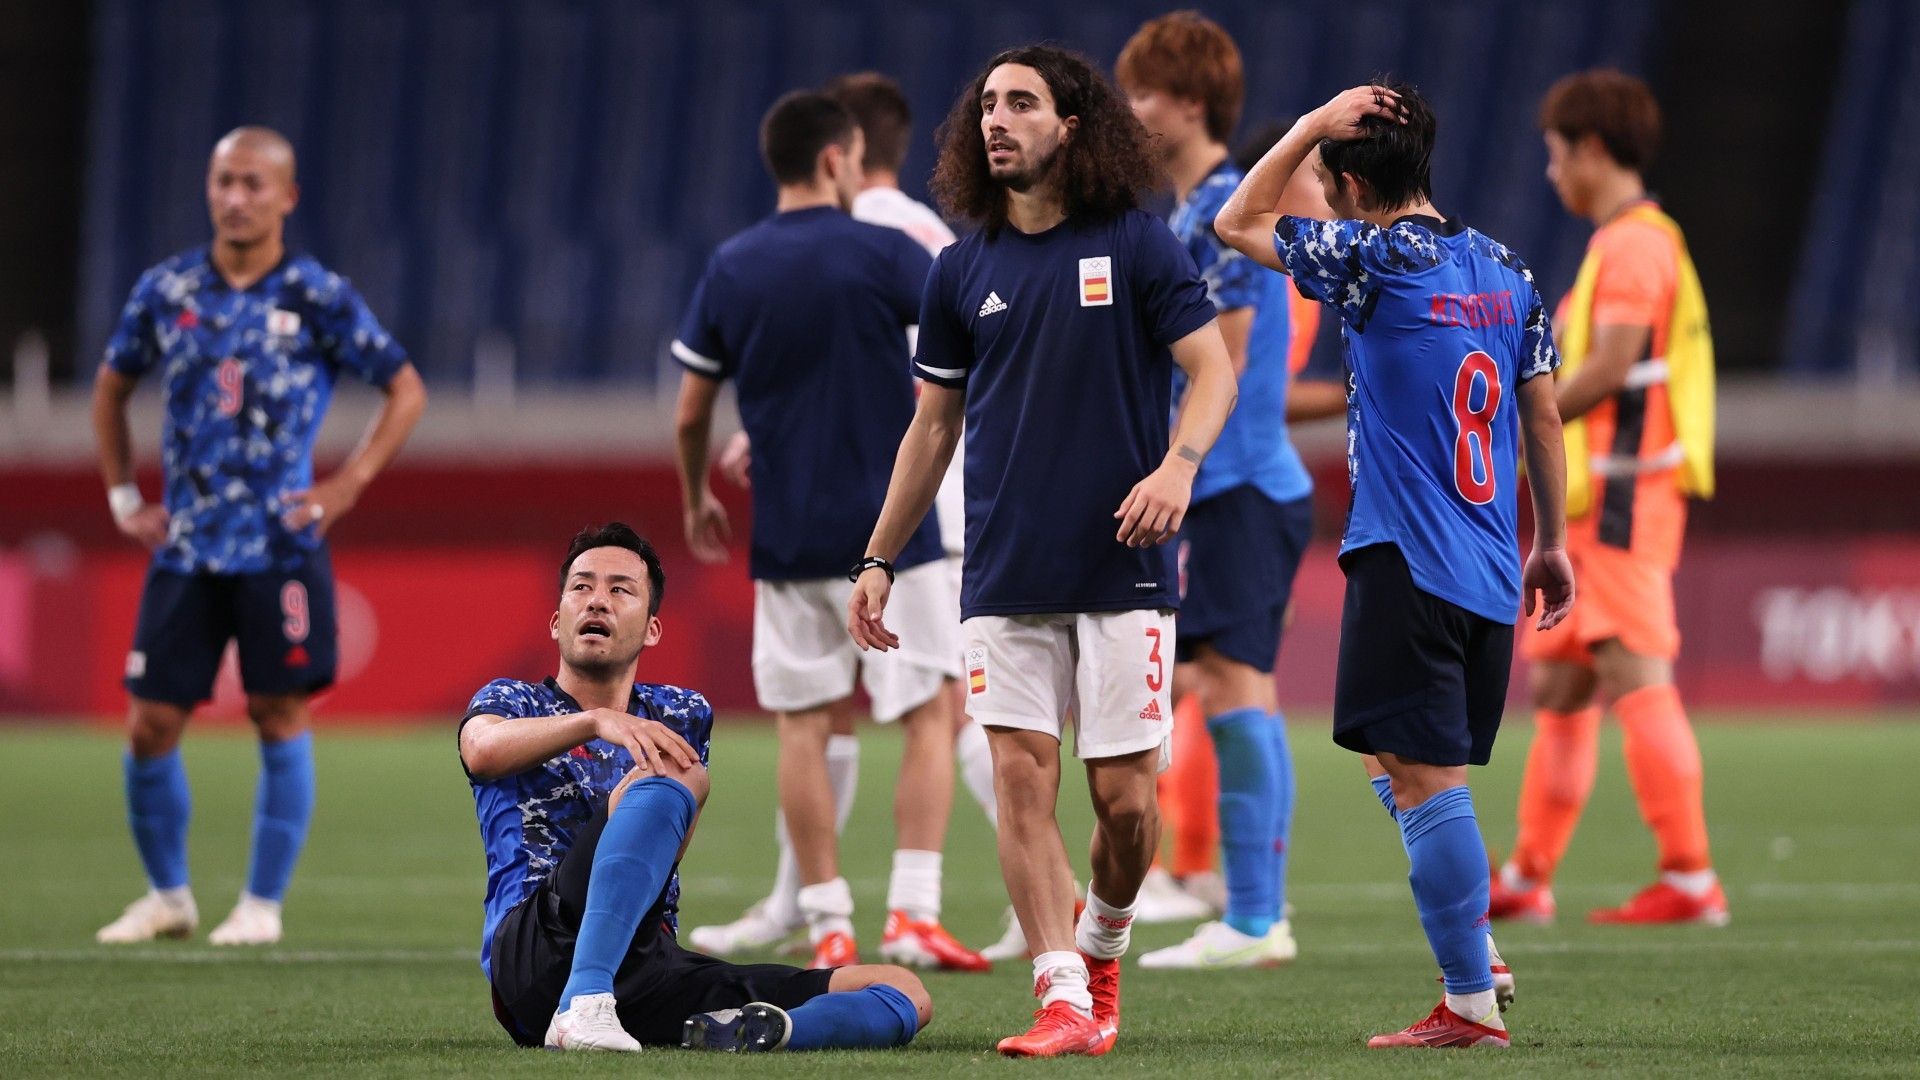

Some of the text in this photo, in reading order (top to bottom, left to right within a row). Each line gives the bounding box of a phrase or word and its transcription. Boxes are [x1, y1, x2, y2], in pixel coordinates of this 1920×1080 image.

[979, 302, 1008, 317] adidas
[217, 358, 245, 417] 9
[1453, 350, 1502, 505] 8
[280, 579, 311, 644] 9
[1145, 627, 1163, 693] 3
[1139, 711, 1162, 721] adidas
